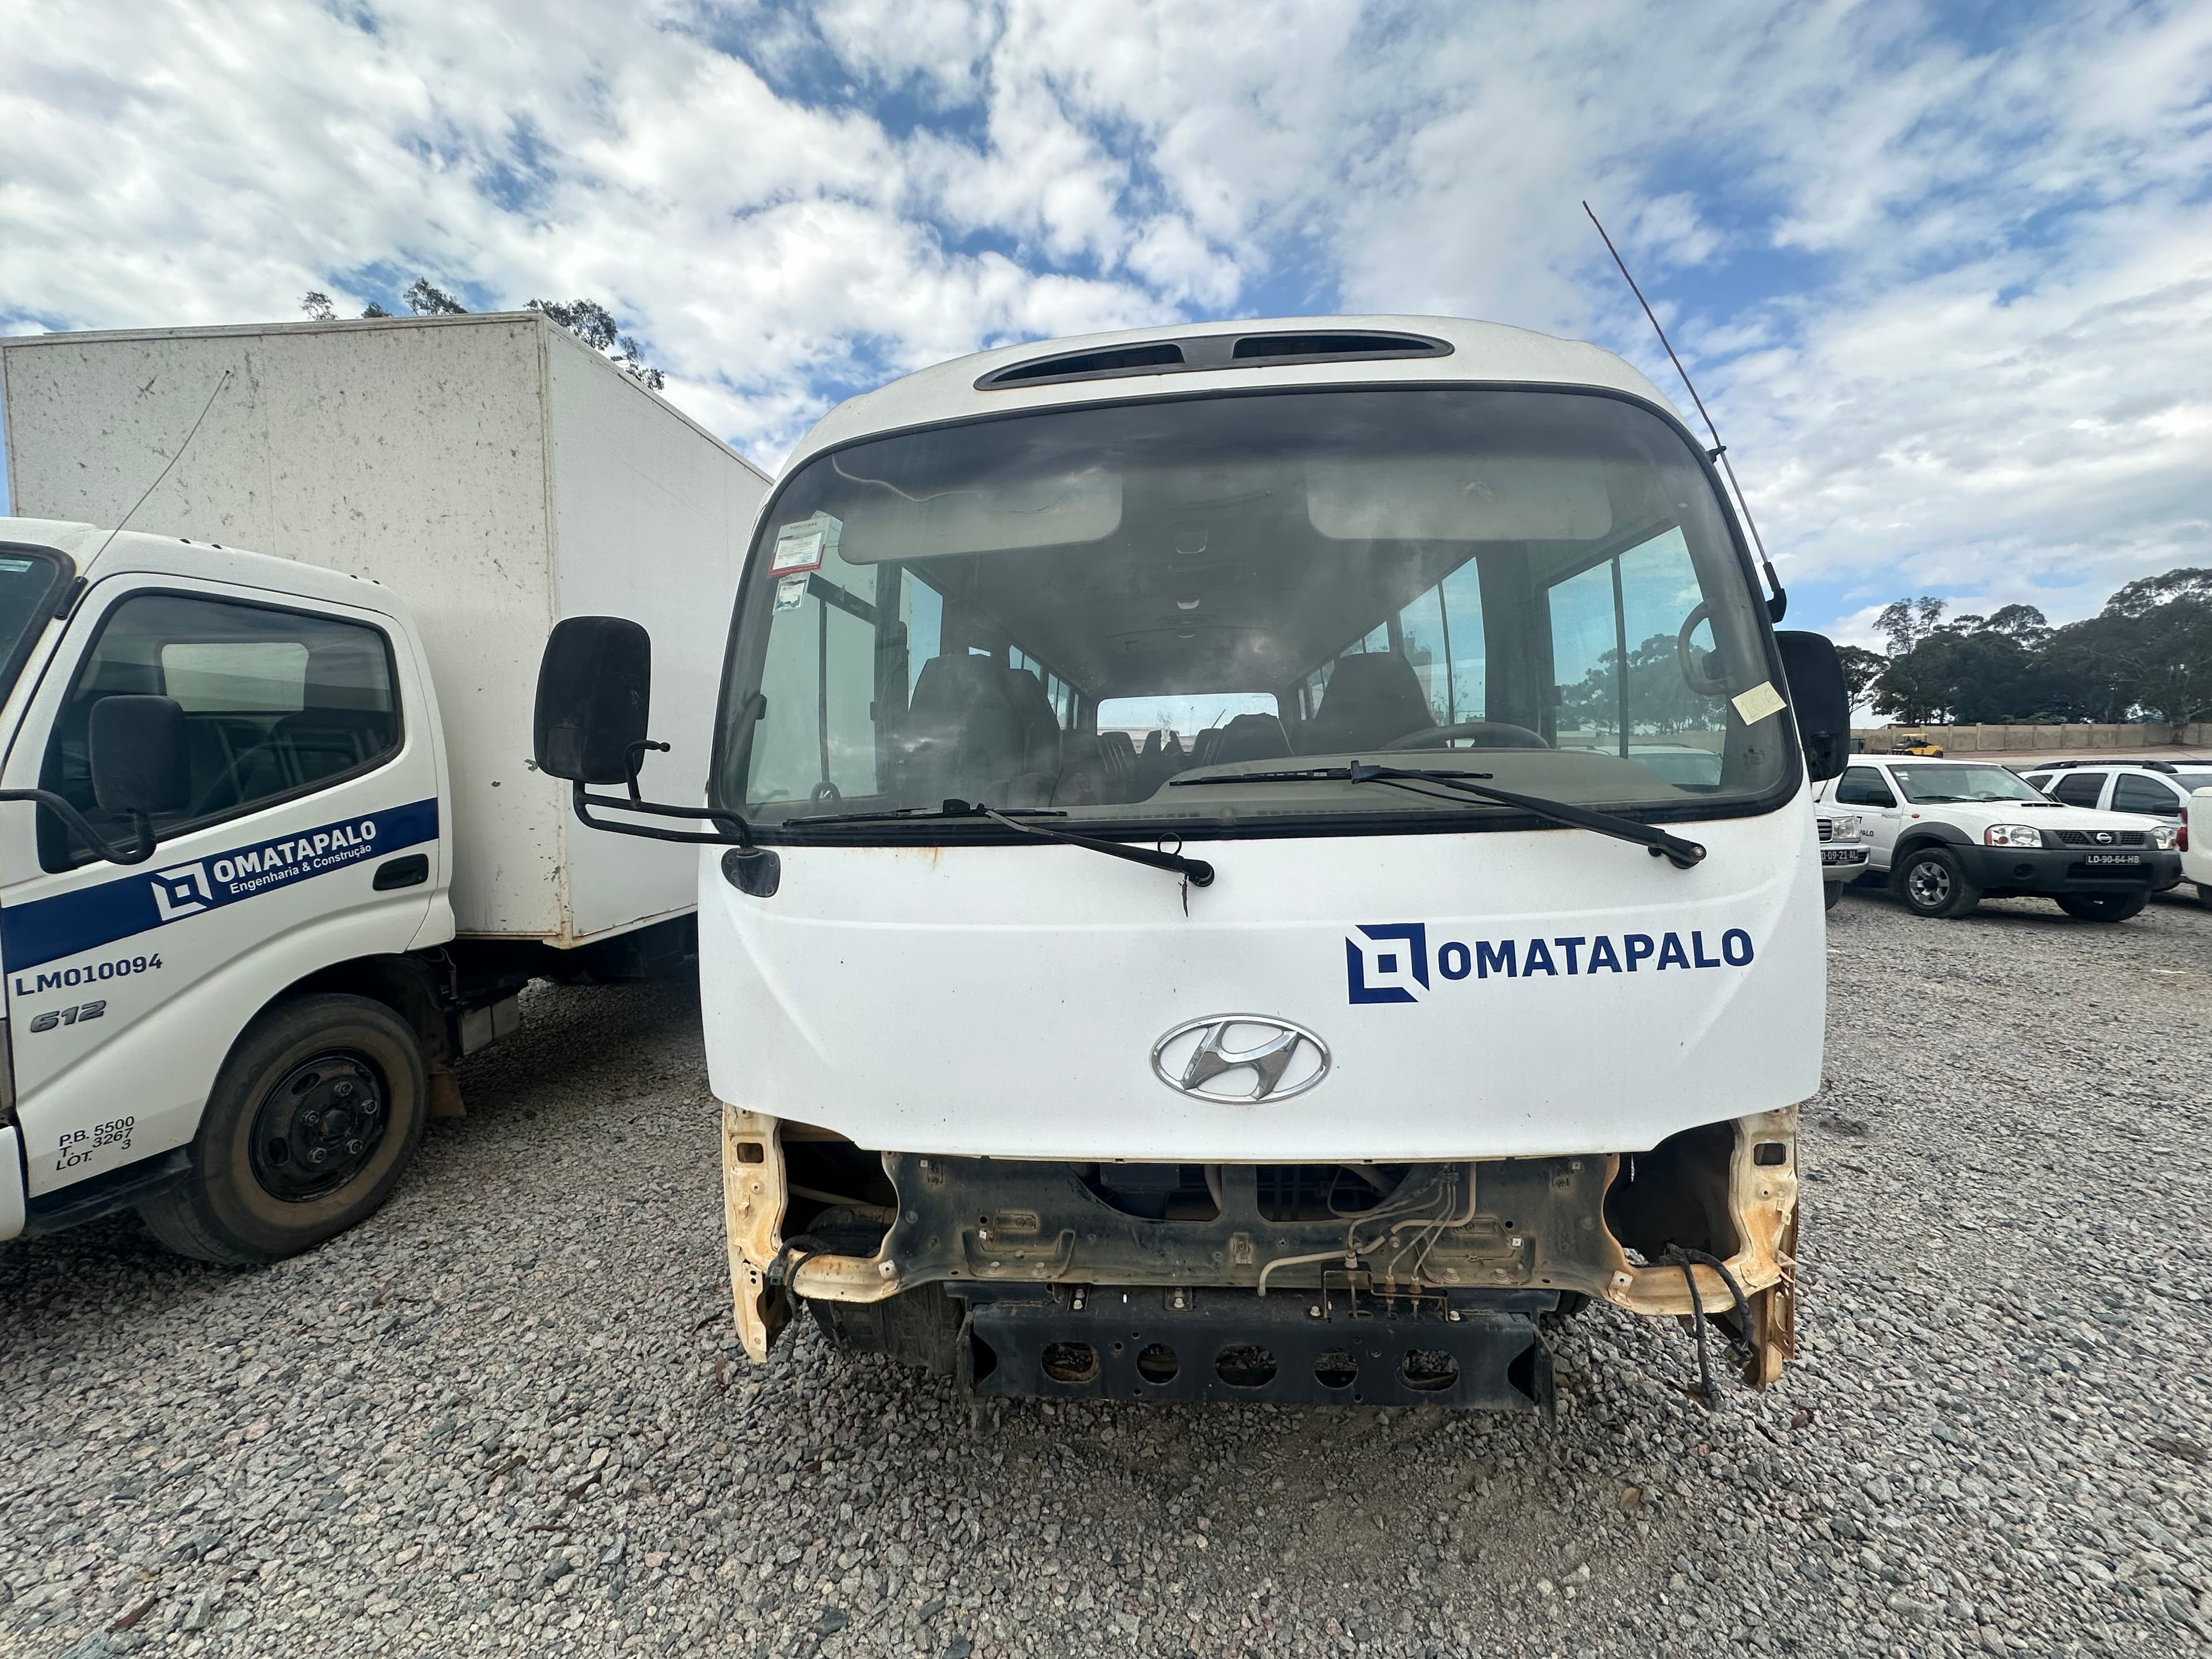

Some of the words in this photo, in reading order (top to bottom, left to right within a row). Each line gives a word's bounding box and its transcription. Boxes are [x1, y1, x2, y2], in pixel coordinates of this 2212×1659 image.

[1741, 688, 1780, 719] 106
[214, 821, 376, 882] OMATAPALO
[230, 866, 300, 893] Engenharia
[302, 863, 310, 872] &
[313, 844, 372, 868] Construção
[1438, 929, 1754, 980] OMATAPALO
[16, 953, 162, 996] LM010094
[31, 1000, 107, 1033] 612
[59, 1130, 89, 1146] P.B.
[94, 1116, 134, 1136] 5500
[59, 1146, 74, 1157] T.
[92, 1127, 134, 1147] 3267
[56, 1150, 93, 1171] LOT.
[122, 1139, 131, 1150] 3
